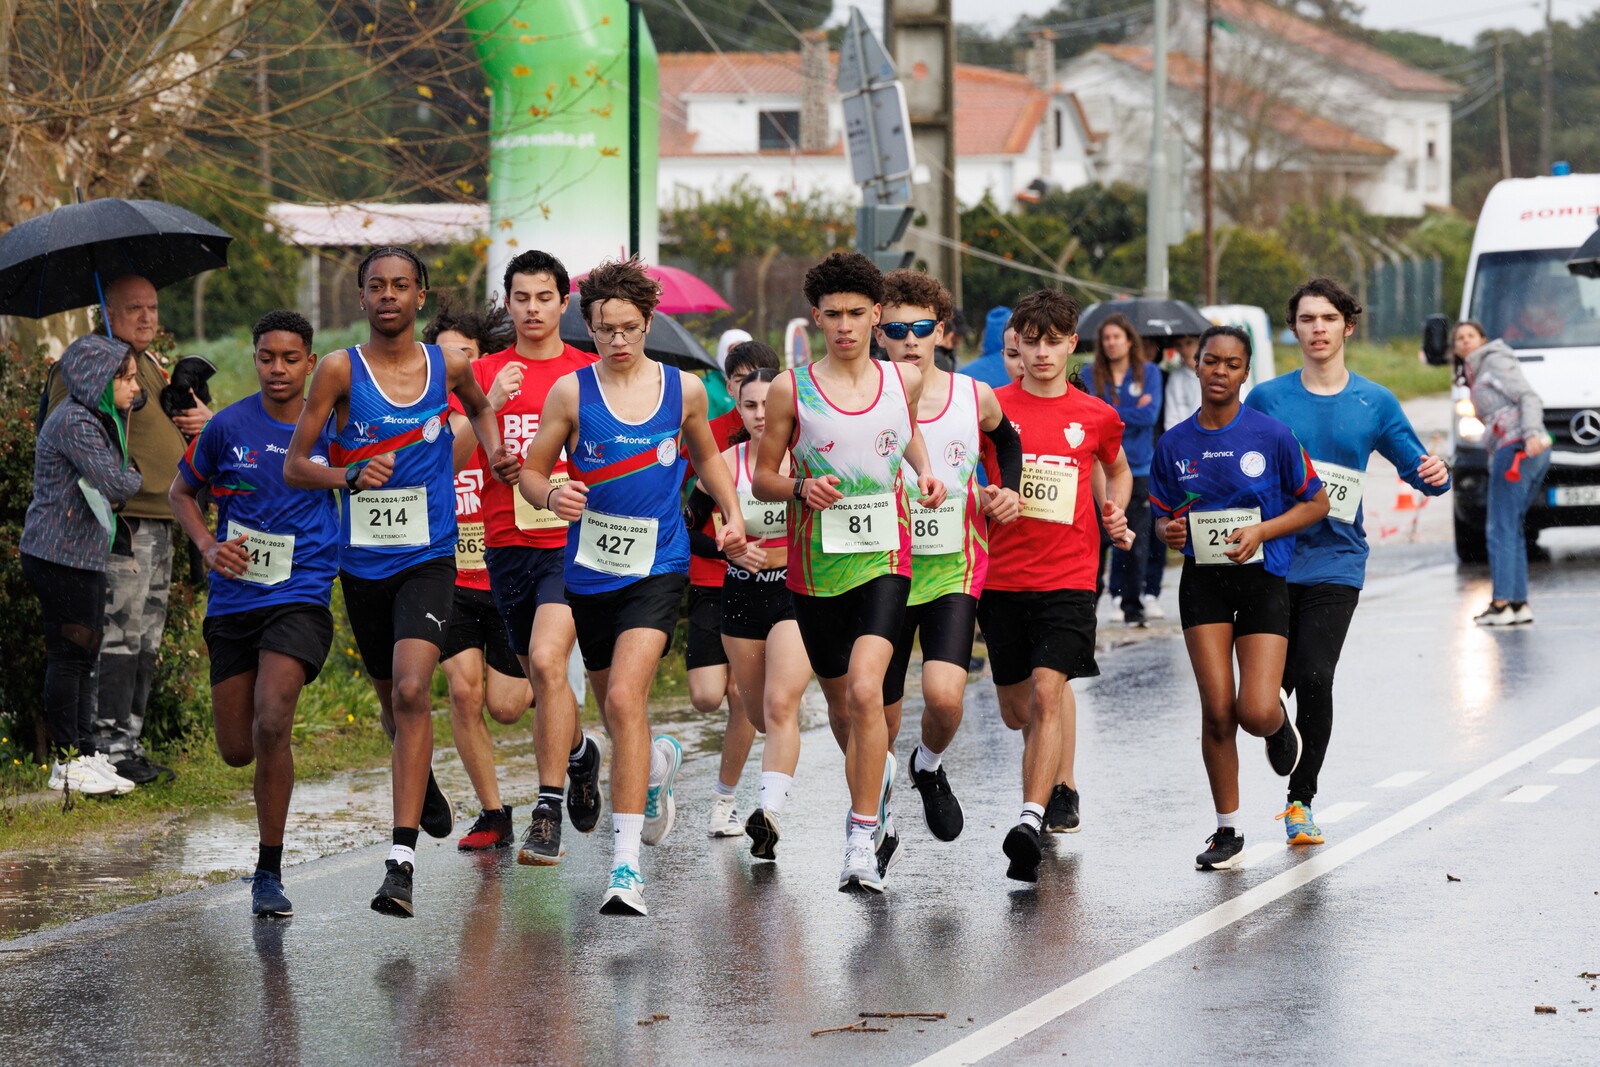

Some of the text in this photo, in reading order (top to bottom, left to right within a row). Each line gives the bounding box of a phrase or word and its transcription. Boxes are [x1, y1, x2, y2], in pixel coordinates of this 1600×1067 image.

[232, 446, 259, 463] VRC
[1044, 470, 1073, 478] ATLETISMO
[1175, 458, 1199, 475] VRC
[357, 495, 418, 503] ÉPOCA 2024/2025
[1023, 481, 1058, 501] 660
[854, 501, 888, 510] 2024/2025
[369, 508, 408, 526] 214
[588, 517, 648, 533] ÉPOCA 2024/2025
[763, 510, 786, 525] 84
[849, 514, 872, 533] 81
[1218, 515, 1253, 524] 2024/2025
[914, 519, 939, 537] 86
[250, 536, 286, 548] 2024/2025
[457, 538, 486, 554] 663
[596, 534, 636, 556] 427
[597, 558, 631, 569] ATLETISMOITA
